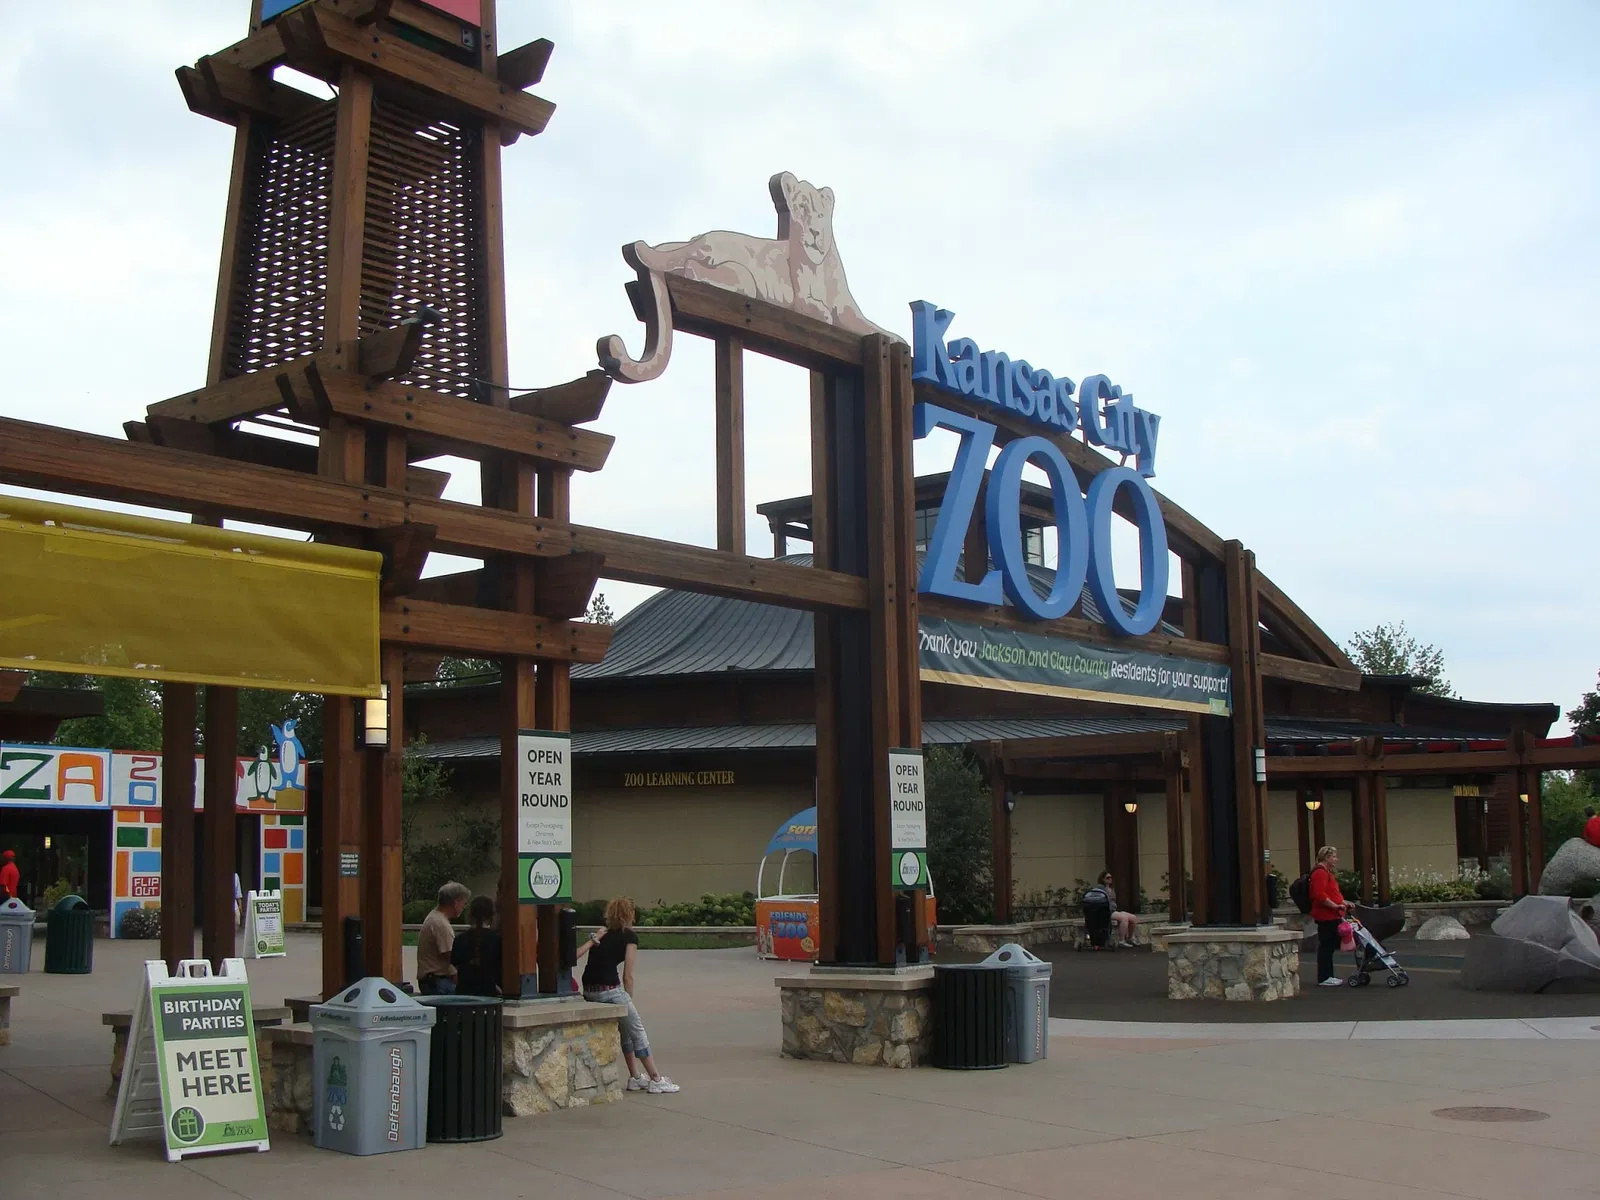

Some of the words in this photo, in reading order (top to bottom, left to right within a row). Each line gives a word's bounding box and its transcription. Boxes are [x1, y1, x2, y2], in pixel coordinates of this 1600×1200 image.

[909, 300, 1079, 433] Kansas
[1078, 373, 1162, 479] City
[911, 401, 1170, 635] ZOO
[953, 638, 978, 659] you
[979, 641, 1026, 666] Jackson
[1028, 650, 1049, 669] and
[1050, 650, 1073, 675] Clay
[1073, 654, 1110, 679] County
[1111, 660, 1157, 683] Residents
[1156, 667, 1170, 686] for
[1172, 671, 1192, 688] your
[1193, 674, 1229, 693] support!
[527, 749, 562, 764] OPEN
[895, 764, 919, 776] OPEN
[528, 771, 562, 786] YEAR
[624, 773, 644, 787] ZOO
[646, 771, 695, 786] LEARNING
[697, 770, 735, 785] CENTER
[897, 782, 919, 794] YEAR
[521, 793, 569, 808] ROUND
[893, 800, 924, 812] ROUND
[134, 877, 159, 886] FLIP
[135, 886, 158, 896] OUT
[770, 911, 808, 922] FRIENDS
[777, 922, 809, 939] ZOO
[164, 998, 242, 1014] BIRTHDAY
[182, 1016, 245, 1031] PARTIES
[176, 1047, 248, 1072] MEET
[182, 1073, 252, 1098] HERE
[387, 1047, 404, 1142] Deffenbaugh
